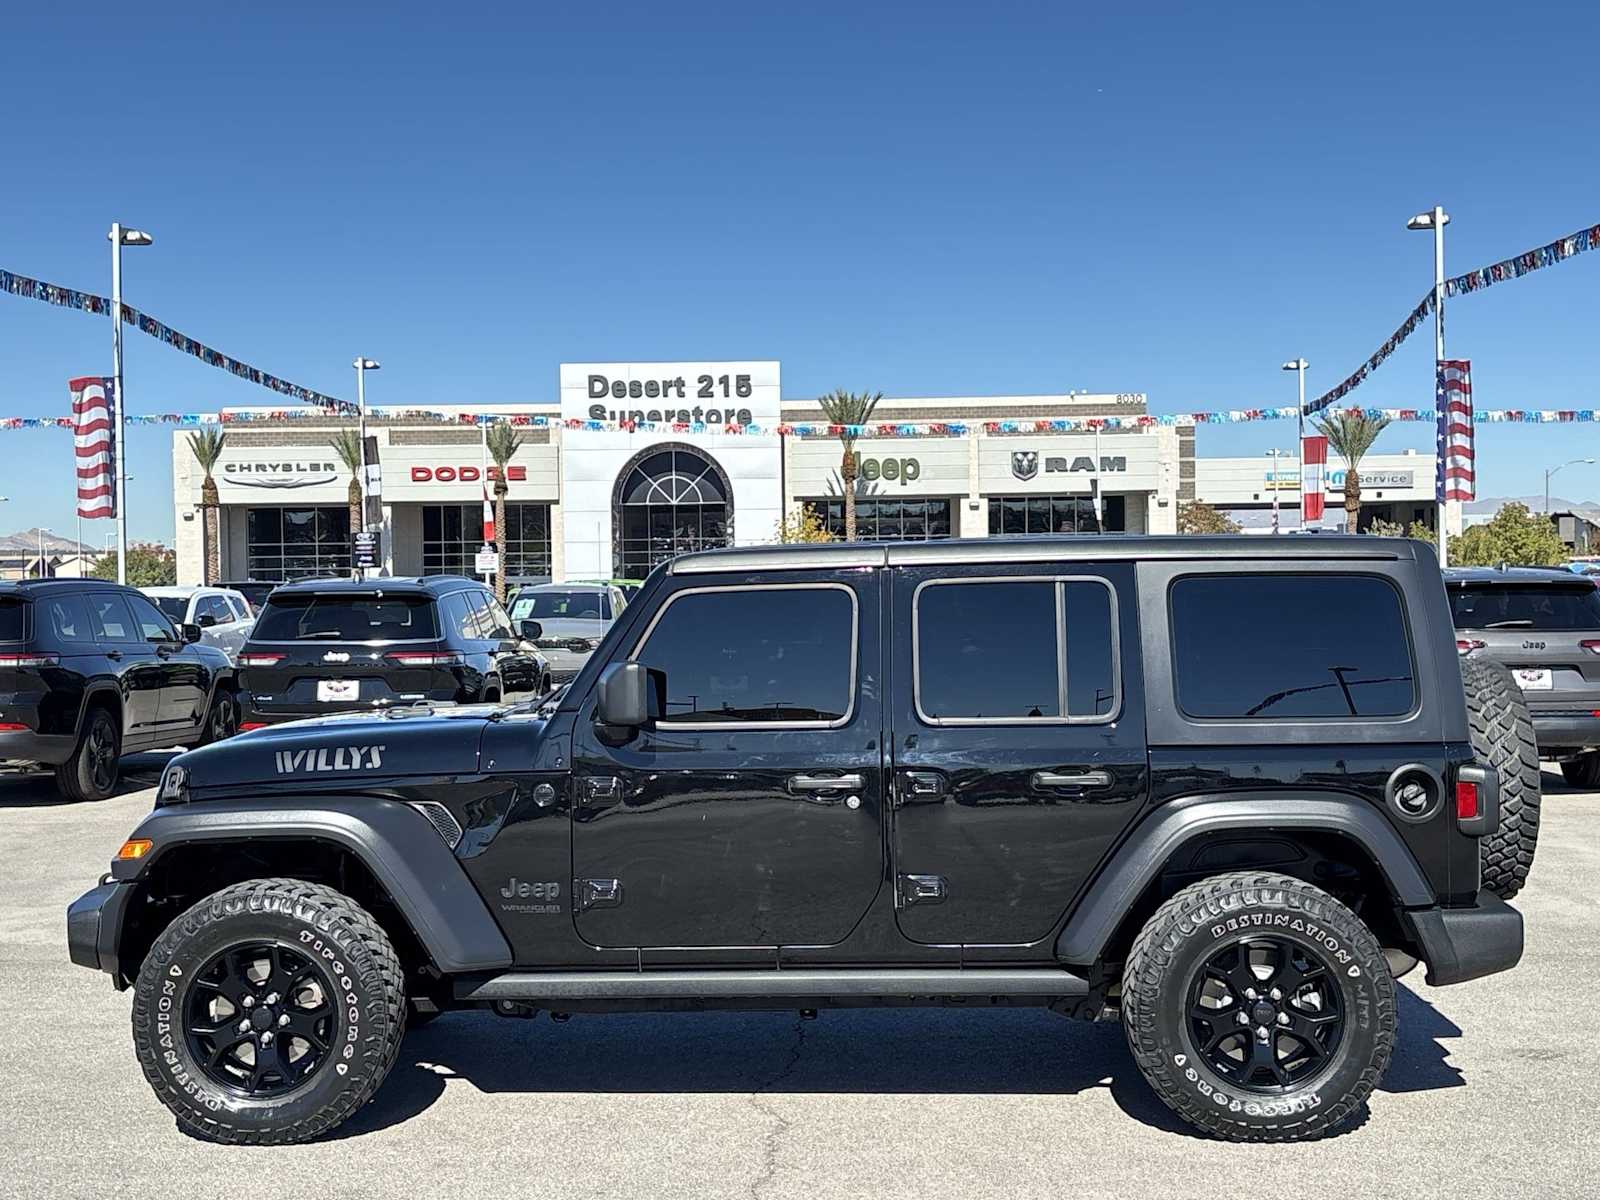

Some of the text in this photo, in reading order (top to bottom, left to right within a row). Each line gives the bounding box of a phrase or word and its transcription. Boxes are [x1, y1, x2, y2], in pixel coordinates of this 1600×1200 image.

[588, 374, 752, 399] Desert 215
[588, 404, 753, 426] Superstore
[225, 463, 335, 473] CHRYSLER
[1045, 456, 1127, 472] RAM
[1522, 641, 1546, 650] Jeep
[275, 745, 386, 773] WILLYS
[500, 878, 560, 901] Jeep
[501, 904, 560, 913] WRANGLER
[1210, 913, 1352, 964] DESTINATION
[157, 980, 222, 1112] DESTINATION
